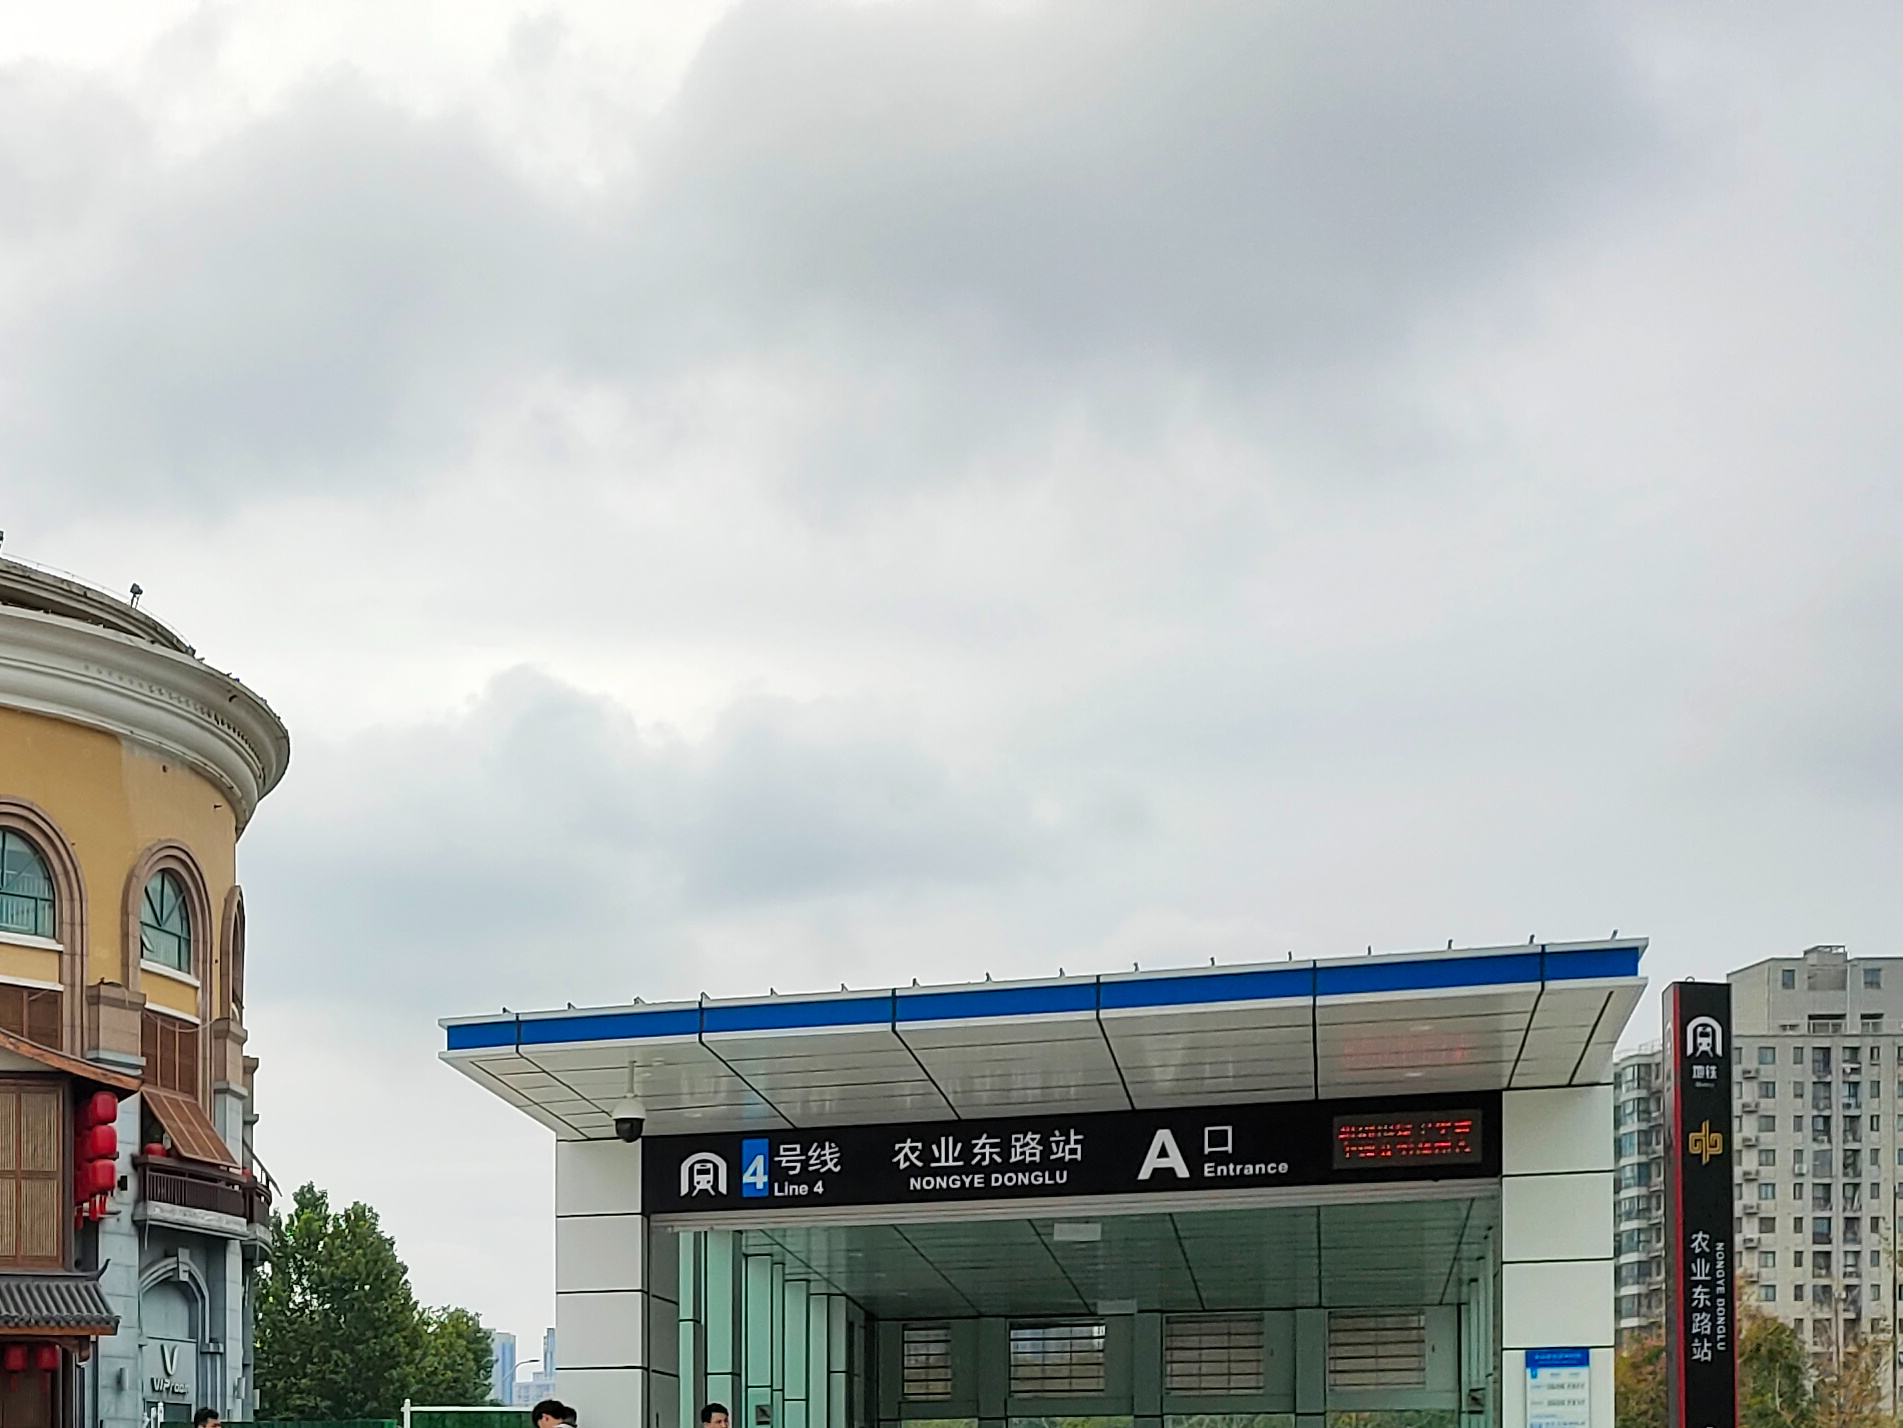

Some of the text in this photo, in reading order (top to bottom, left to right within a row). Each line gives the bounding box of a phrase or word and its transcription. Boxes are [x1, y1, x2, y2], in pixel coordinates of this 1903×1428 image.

[1691, 1064, 1718, 1080] 地铁
[892, 1129, 1085, 1171] 农业东路站
[1136, 1128, 1191, 1180] A
[1204, 1125, 1233, 1155] 口
[742, 1141, 842, 1190] 4 号线
[909, 1170, 1068, 1191] NONGYE DONGLU
[1204, 1161, 1289, 1177] Entrance
[774, 1180, 825, 1197] Line 4
[1689, 1230, 1713, 1363] 农业东路站
[1715, 1241, 1727, 1351] NONGYE DONGLU
